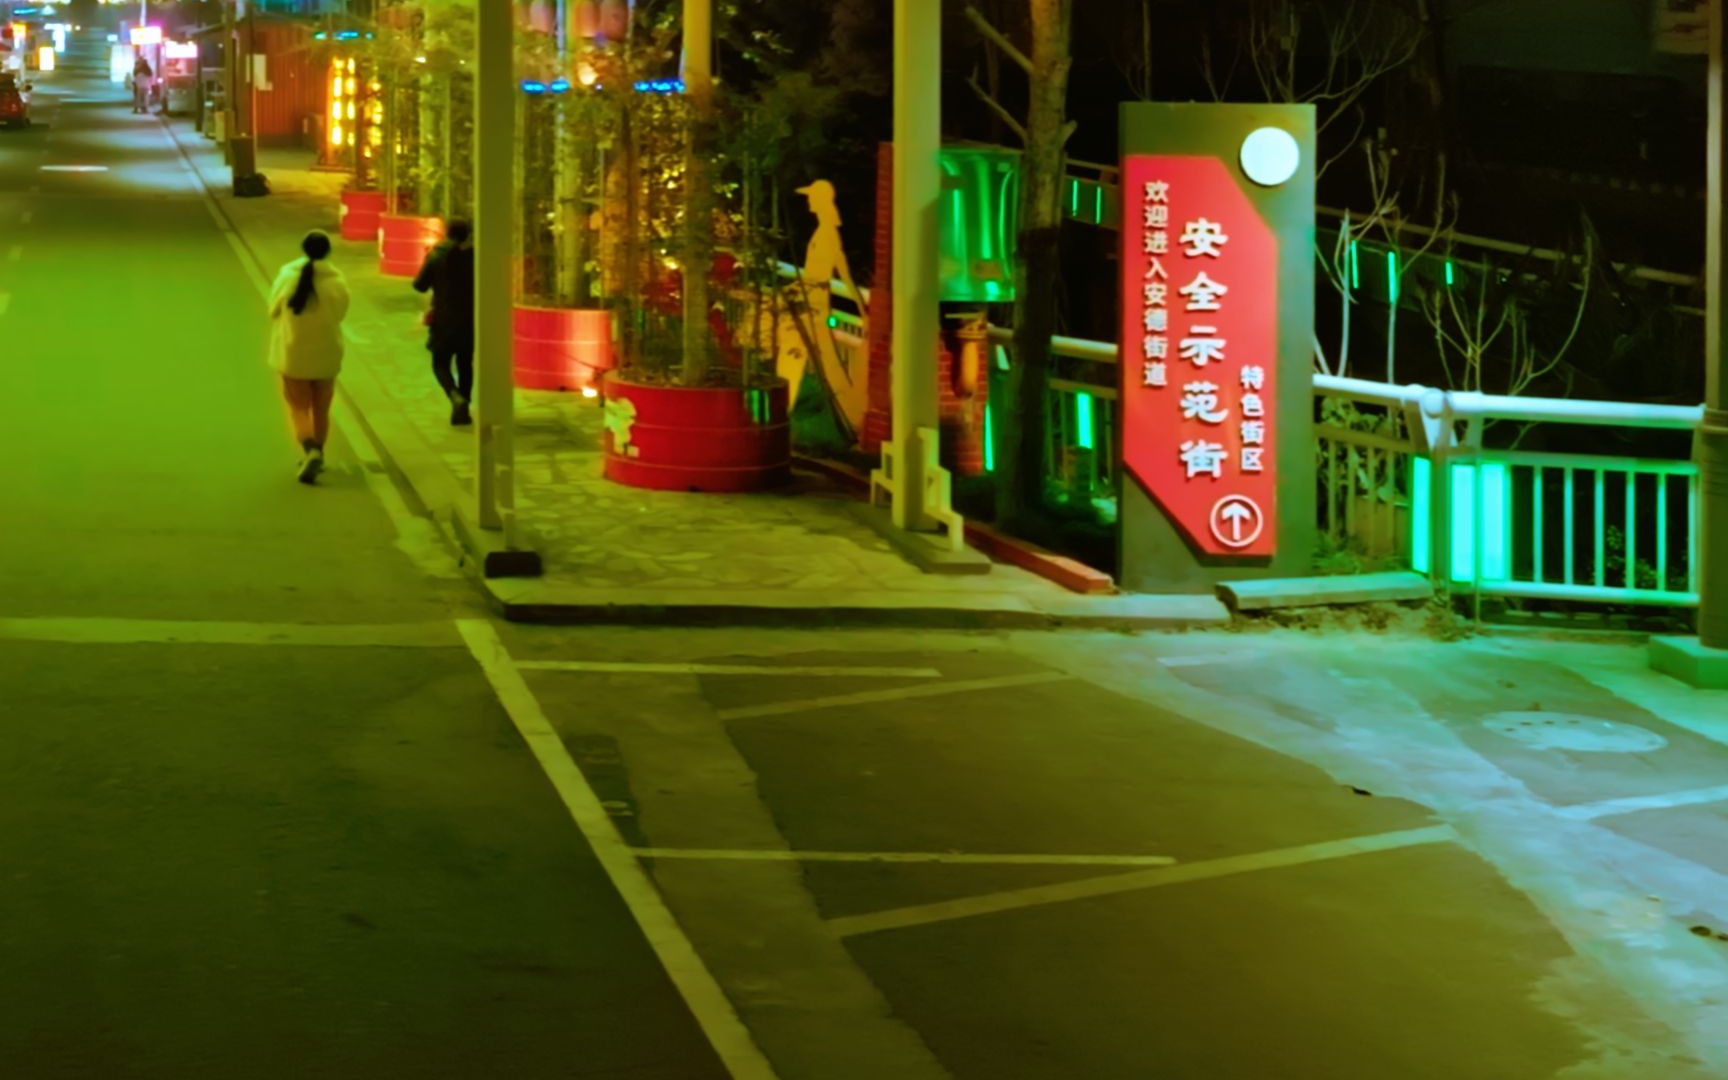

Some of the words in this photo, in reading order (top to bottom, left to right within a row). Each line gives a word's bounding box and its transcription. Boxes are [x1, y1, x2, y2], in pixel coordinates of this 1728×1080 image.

[1143, 180, 1170, 387] 欢迎进入安德街道
[1178, 217, 1229, 479] 安全示范街
[1239, 365, 1265, 473] 特色街区
